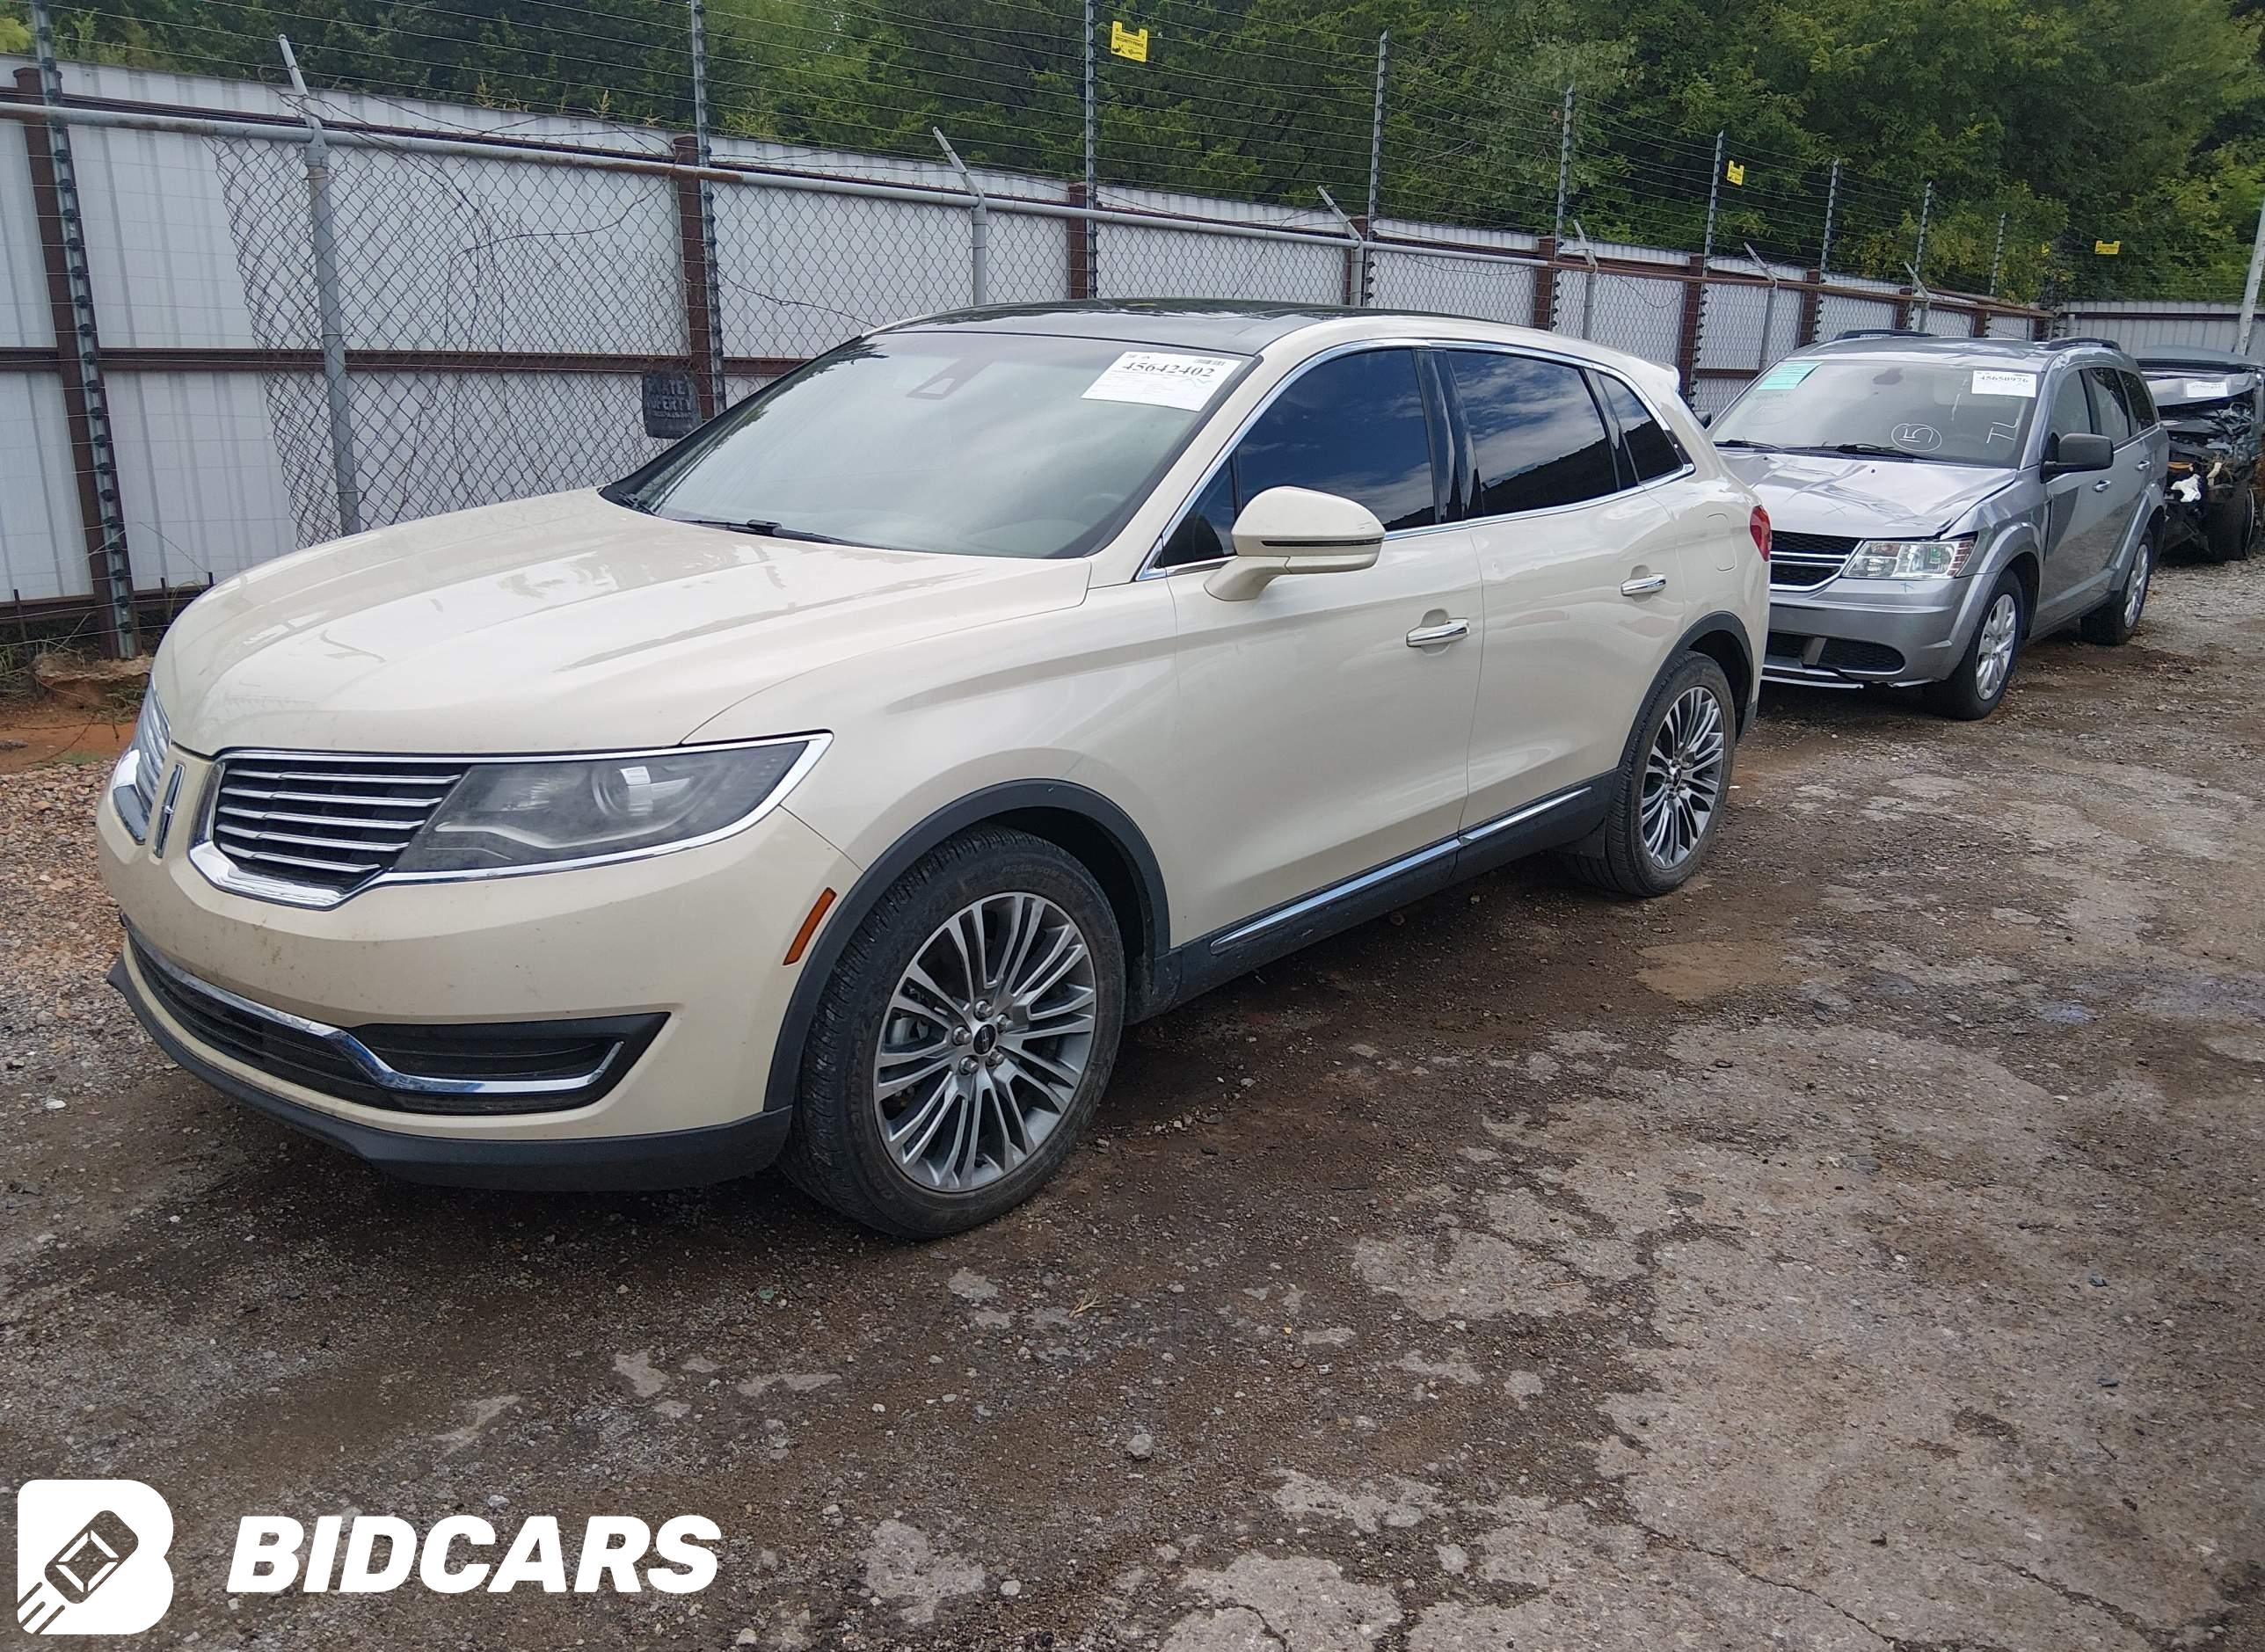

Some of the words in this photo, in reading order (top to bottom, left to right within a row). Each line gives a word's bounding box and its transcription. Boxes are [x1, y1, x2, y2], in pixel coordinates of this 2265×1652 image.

[1122, 361, 1215, 377] 45642402
[646, 378, 686, 395] PATE
[645, 394, 691, 411] OPERTY
